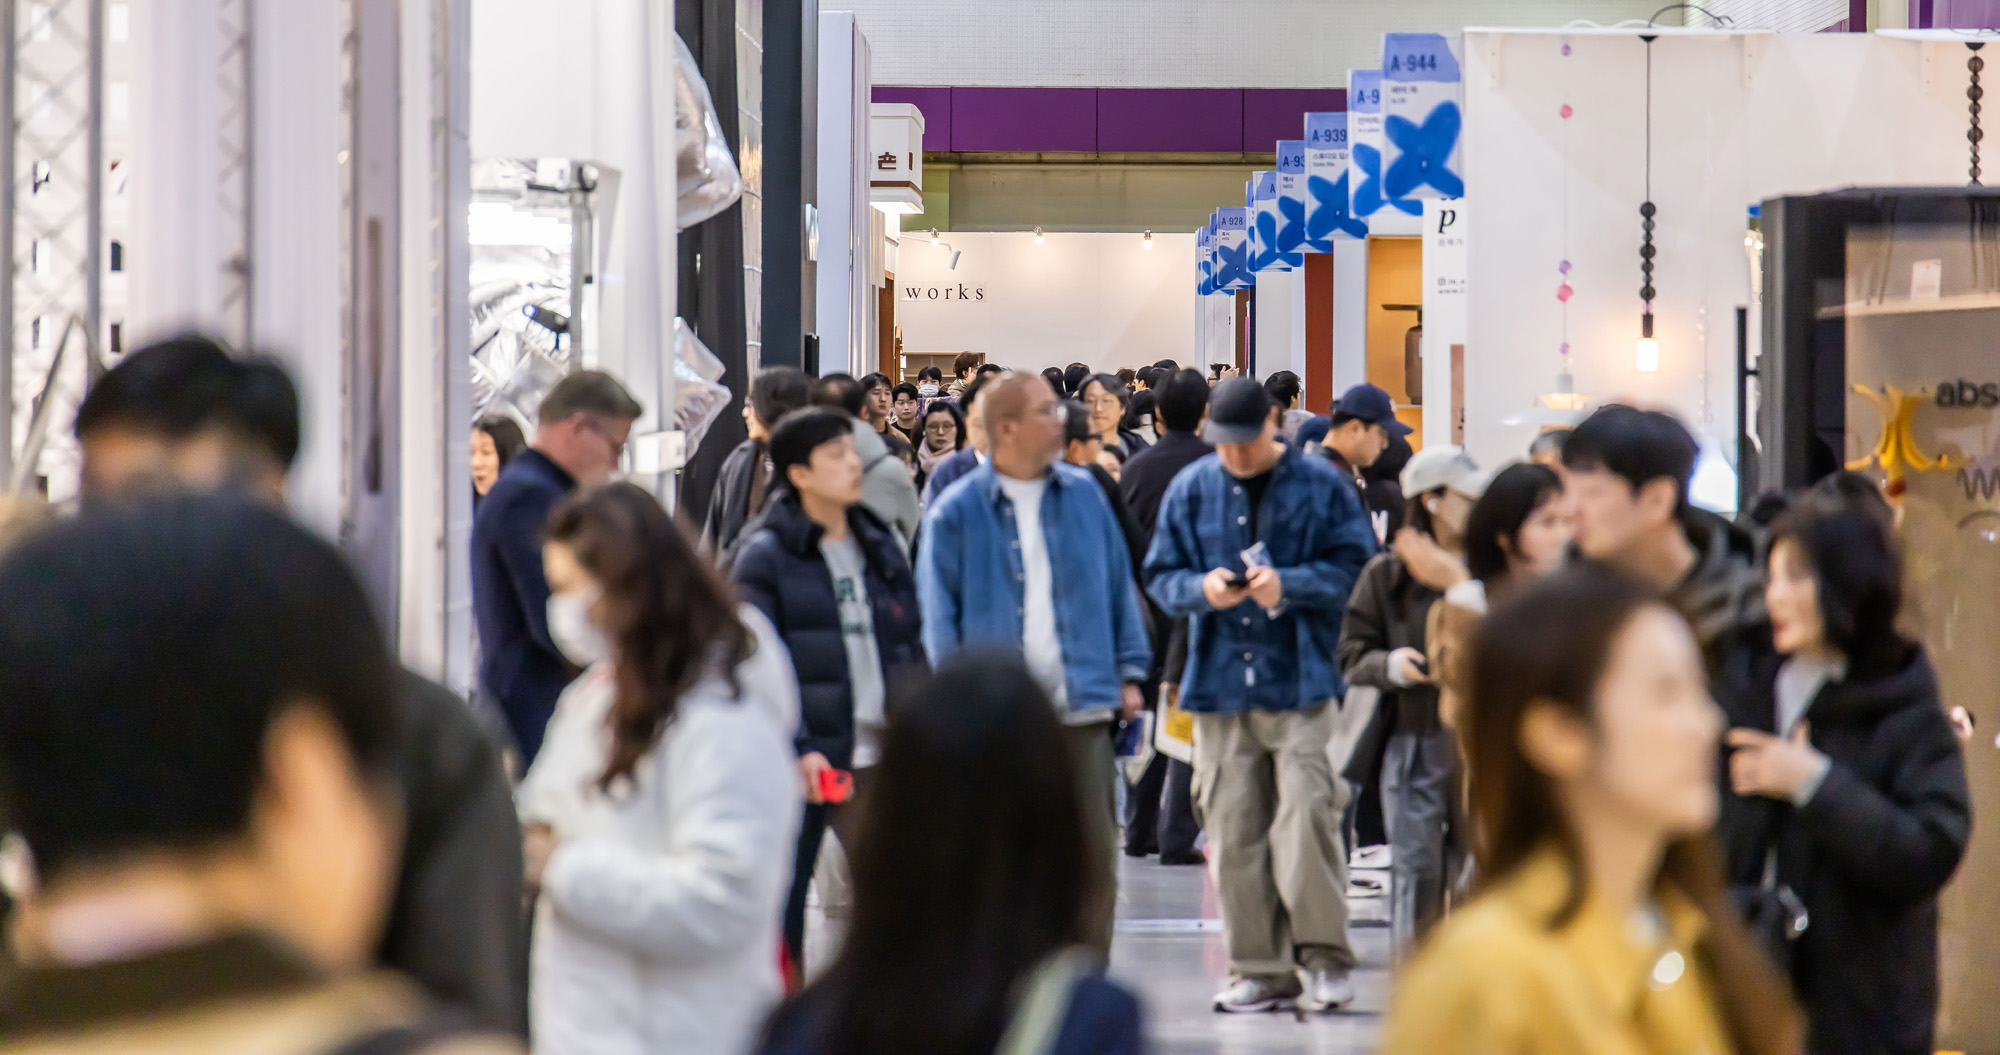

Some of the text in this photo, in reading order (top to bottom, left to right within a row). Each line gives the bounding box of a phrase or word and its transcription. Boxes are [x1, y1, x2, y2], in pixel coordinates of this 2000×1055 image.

[1390, 53, 1437, 72] A-944
[1356, 89, 1380, 104] A-9
[1311, 129, 1348, 142] A-939
[1282, 155, 1305, 167] A-93
[1221, 216, 1244, 226] A-928
[1438, 208, 1456, 234] p
[905, 282, 984, 300] works
